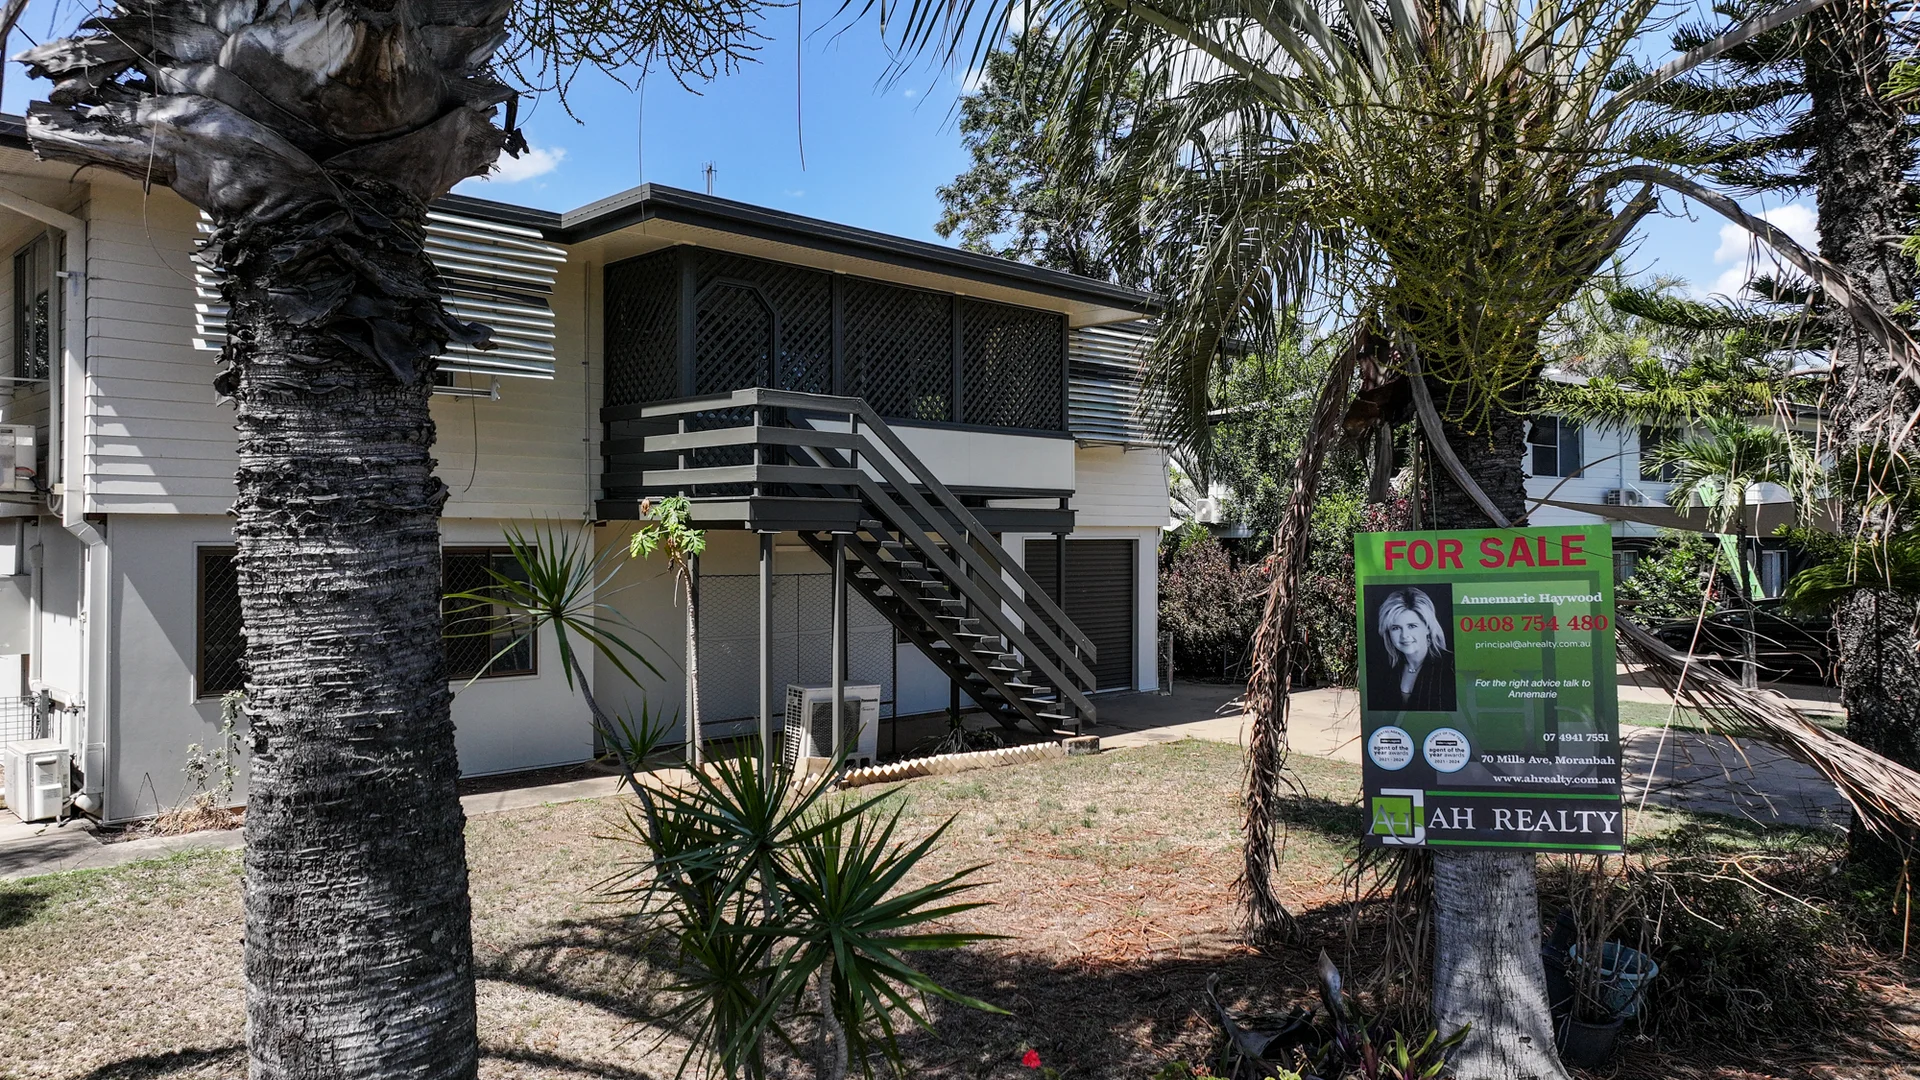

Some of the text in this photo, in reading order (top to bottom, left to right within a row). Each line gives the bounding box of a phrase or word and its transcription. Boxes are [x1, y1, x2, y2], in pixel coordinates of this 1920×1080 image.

[1384, 535, 1587, 570] FOR SALE
[1460, 592, 1603, 606] Annemarie Haywood
[1460, 614, 1609, 632] 0408 754 480
[1475, 640, 1591, 650] principal@ahrealty.com.au
[1475, 679, 1490, 687] For
[1492, 679, 1506, 687] the
[1508, 679, 1529, 690] right
[1530, 679, 1560, 687] advice
[1563, 679, 1579, 687] talk
[1508, 690, 1557, 698] Annemarie
[1543, 733, 1609, 742] 07 4941 7551
[1481, 755, 1616, 765] 70 Mills Ave, Moranbah
[1493, 774, 1616, 785] www.ahrealty.com.au
[1428, 807, 1620, 834] AH REALTY
